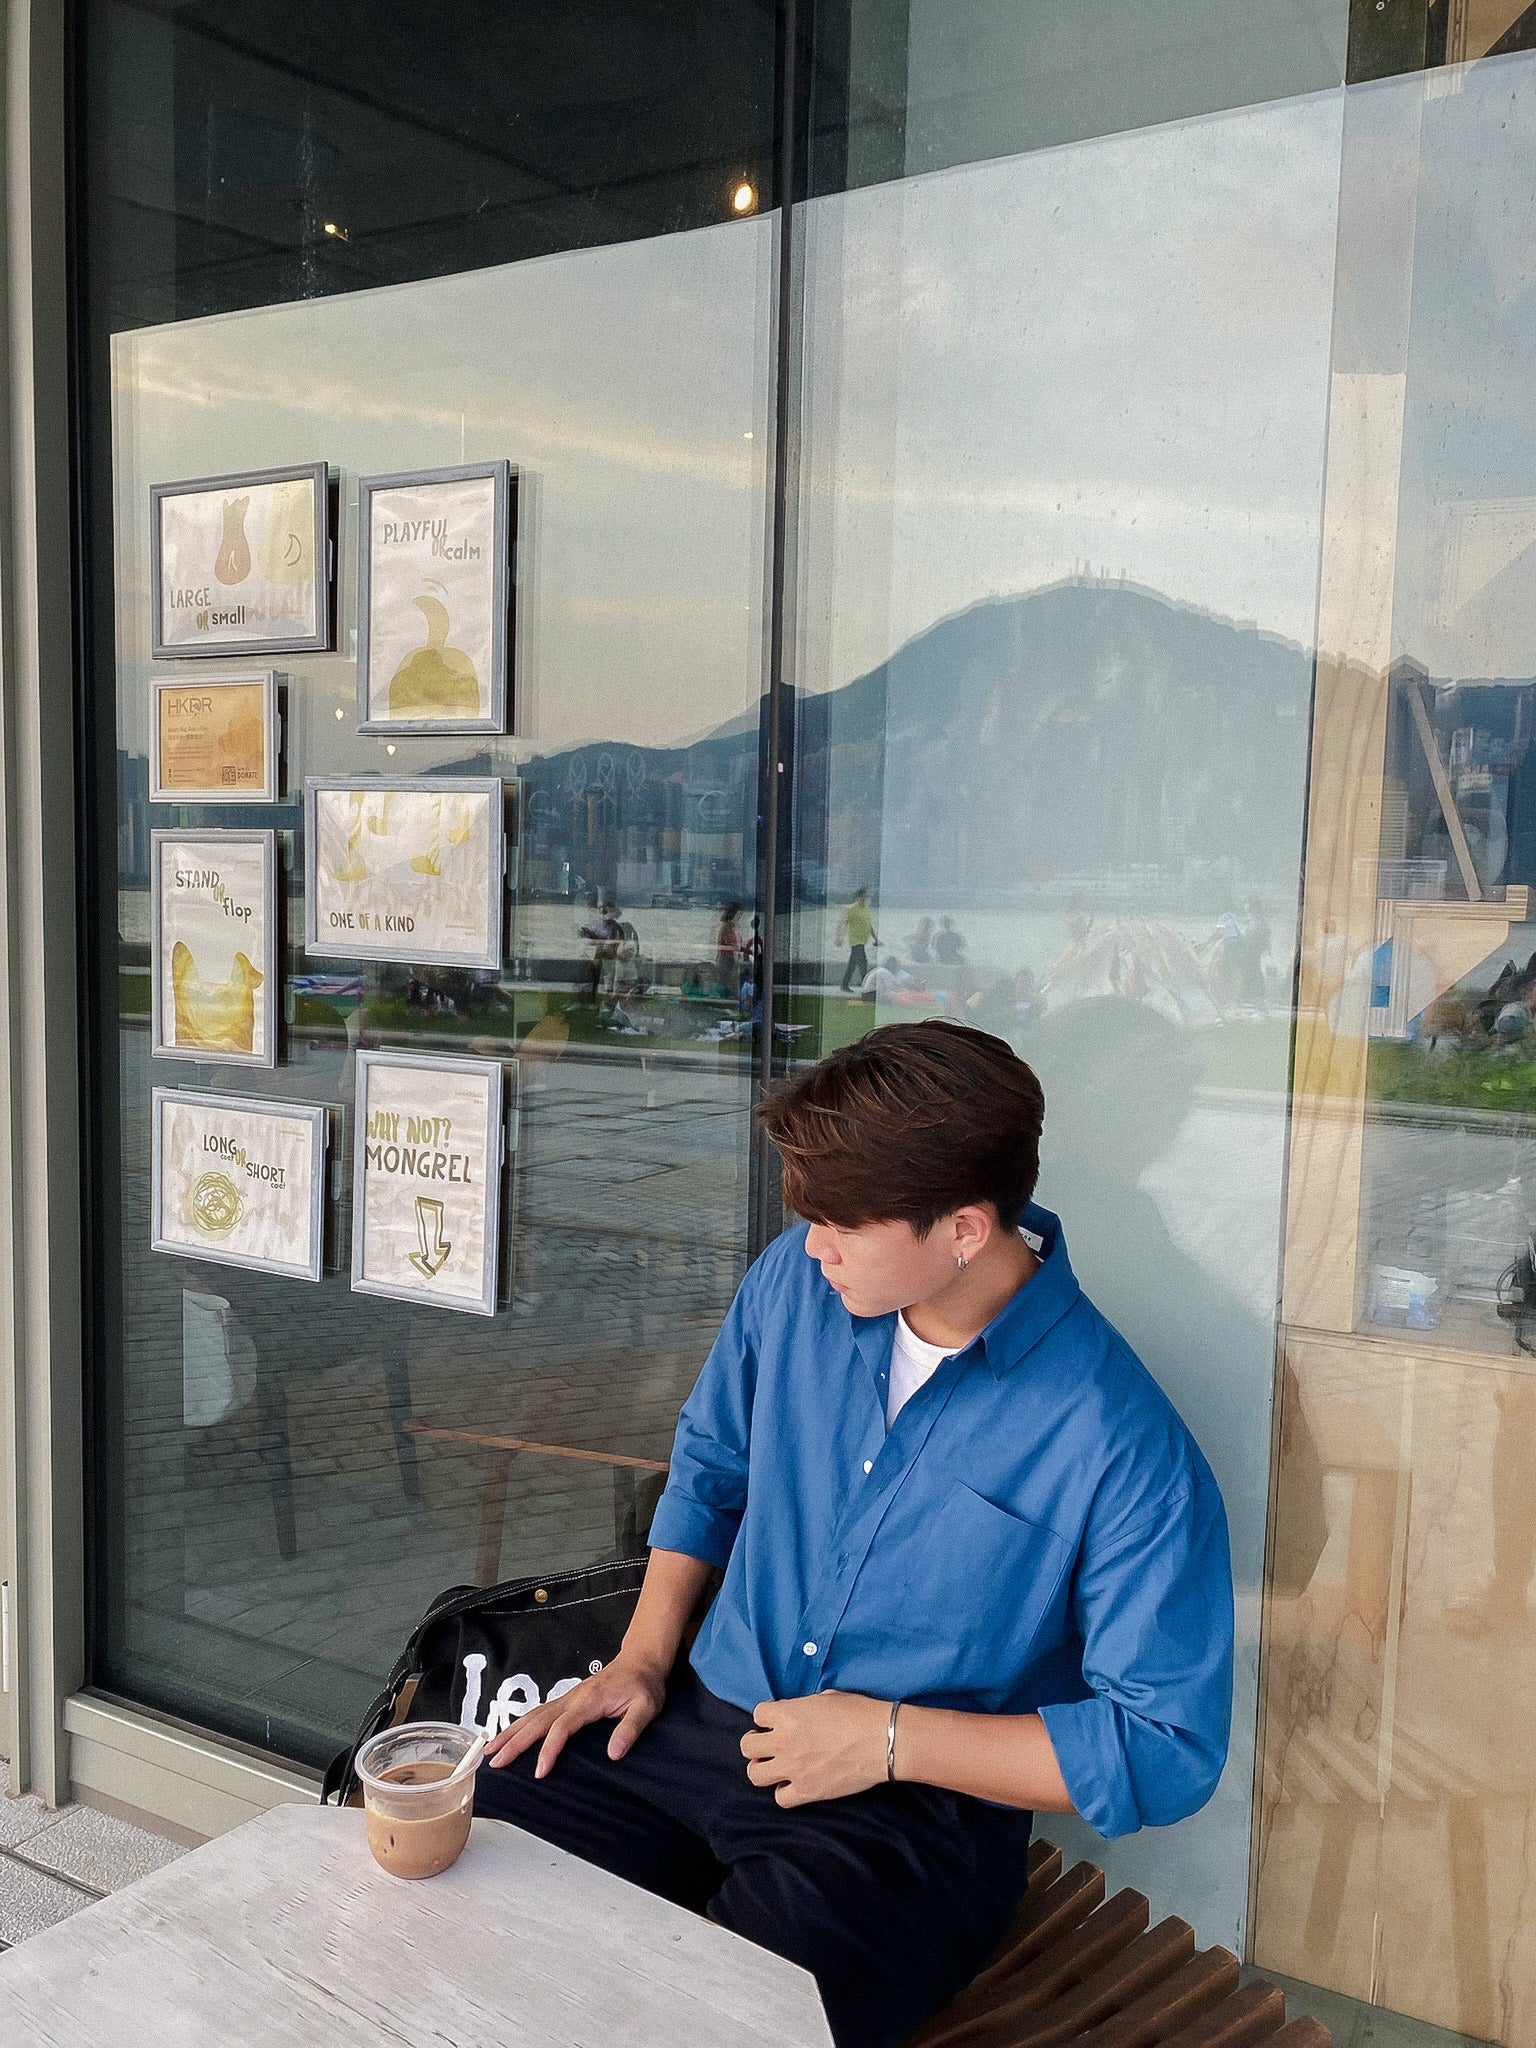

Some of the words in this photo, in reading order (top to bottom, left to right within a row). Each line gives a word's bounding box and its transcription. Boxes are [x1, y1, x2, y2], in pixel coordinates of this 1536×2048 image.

[445, 538, 481, 560] calm
[170, 587, 212, 609] LARGE
[196, 610, 209, 631] OR
[212, 606, 245, 625] small
[175, 870, 220, 889] STAND
[213, 883, 226, 903] OR
[222, 897, 252, 924] flop
[329, 911, 355, 929] ONE
[358, 912, 370, 931] OF
[374, 913, 382, 932] A
[385, 914, 415, 933] KIND
[366, 1110, 400, 1144] WHY
[406, 1115, 452, 1149] NOT?
[203, 1134, 237, 1156] LONG
[235, 1148, 247, 1168] OR
[365, 1144, 472, 1184] MONGREL
[246, 1162, 286, 1184] SHORT
